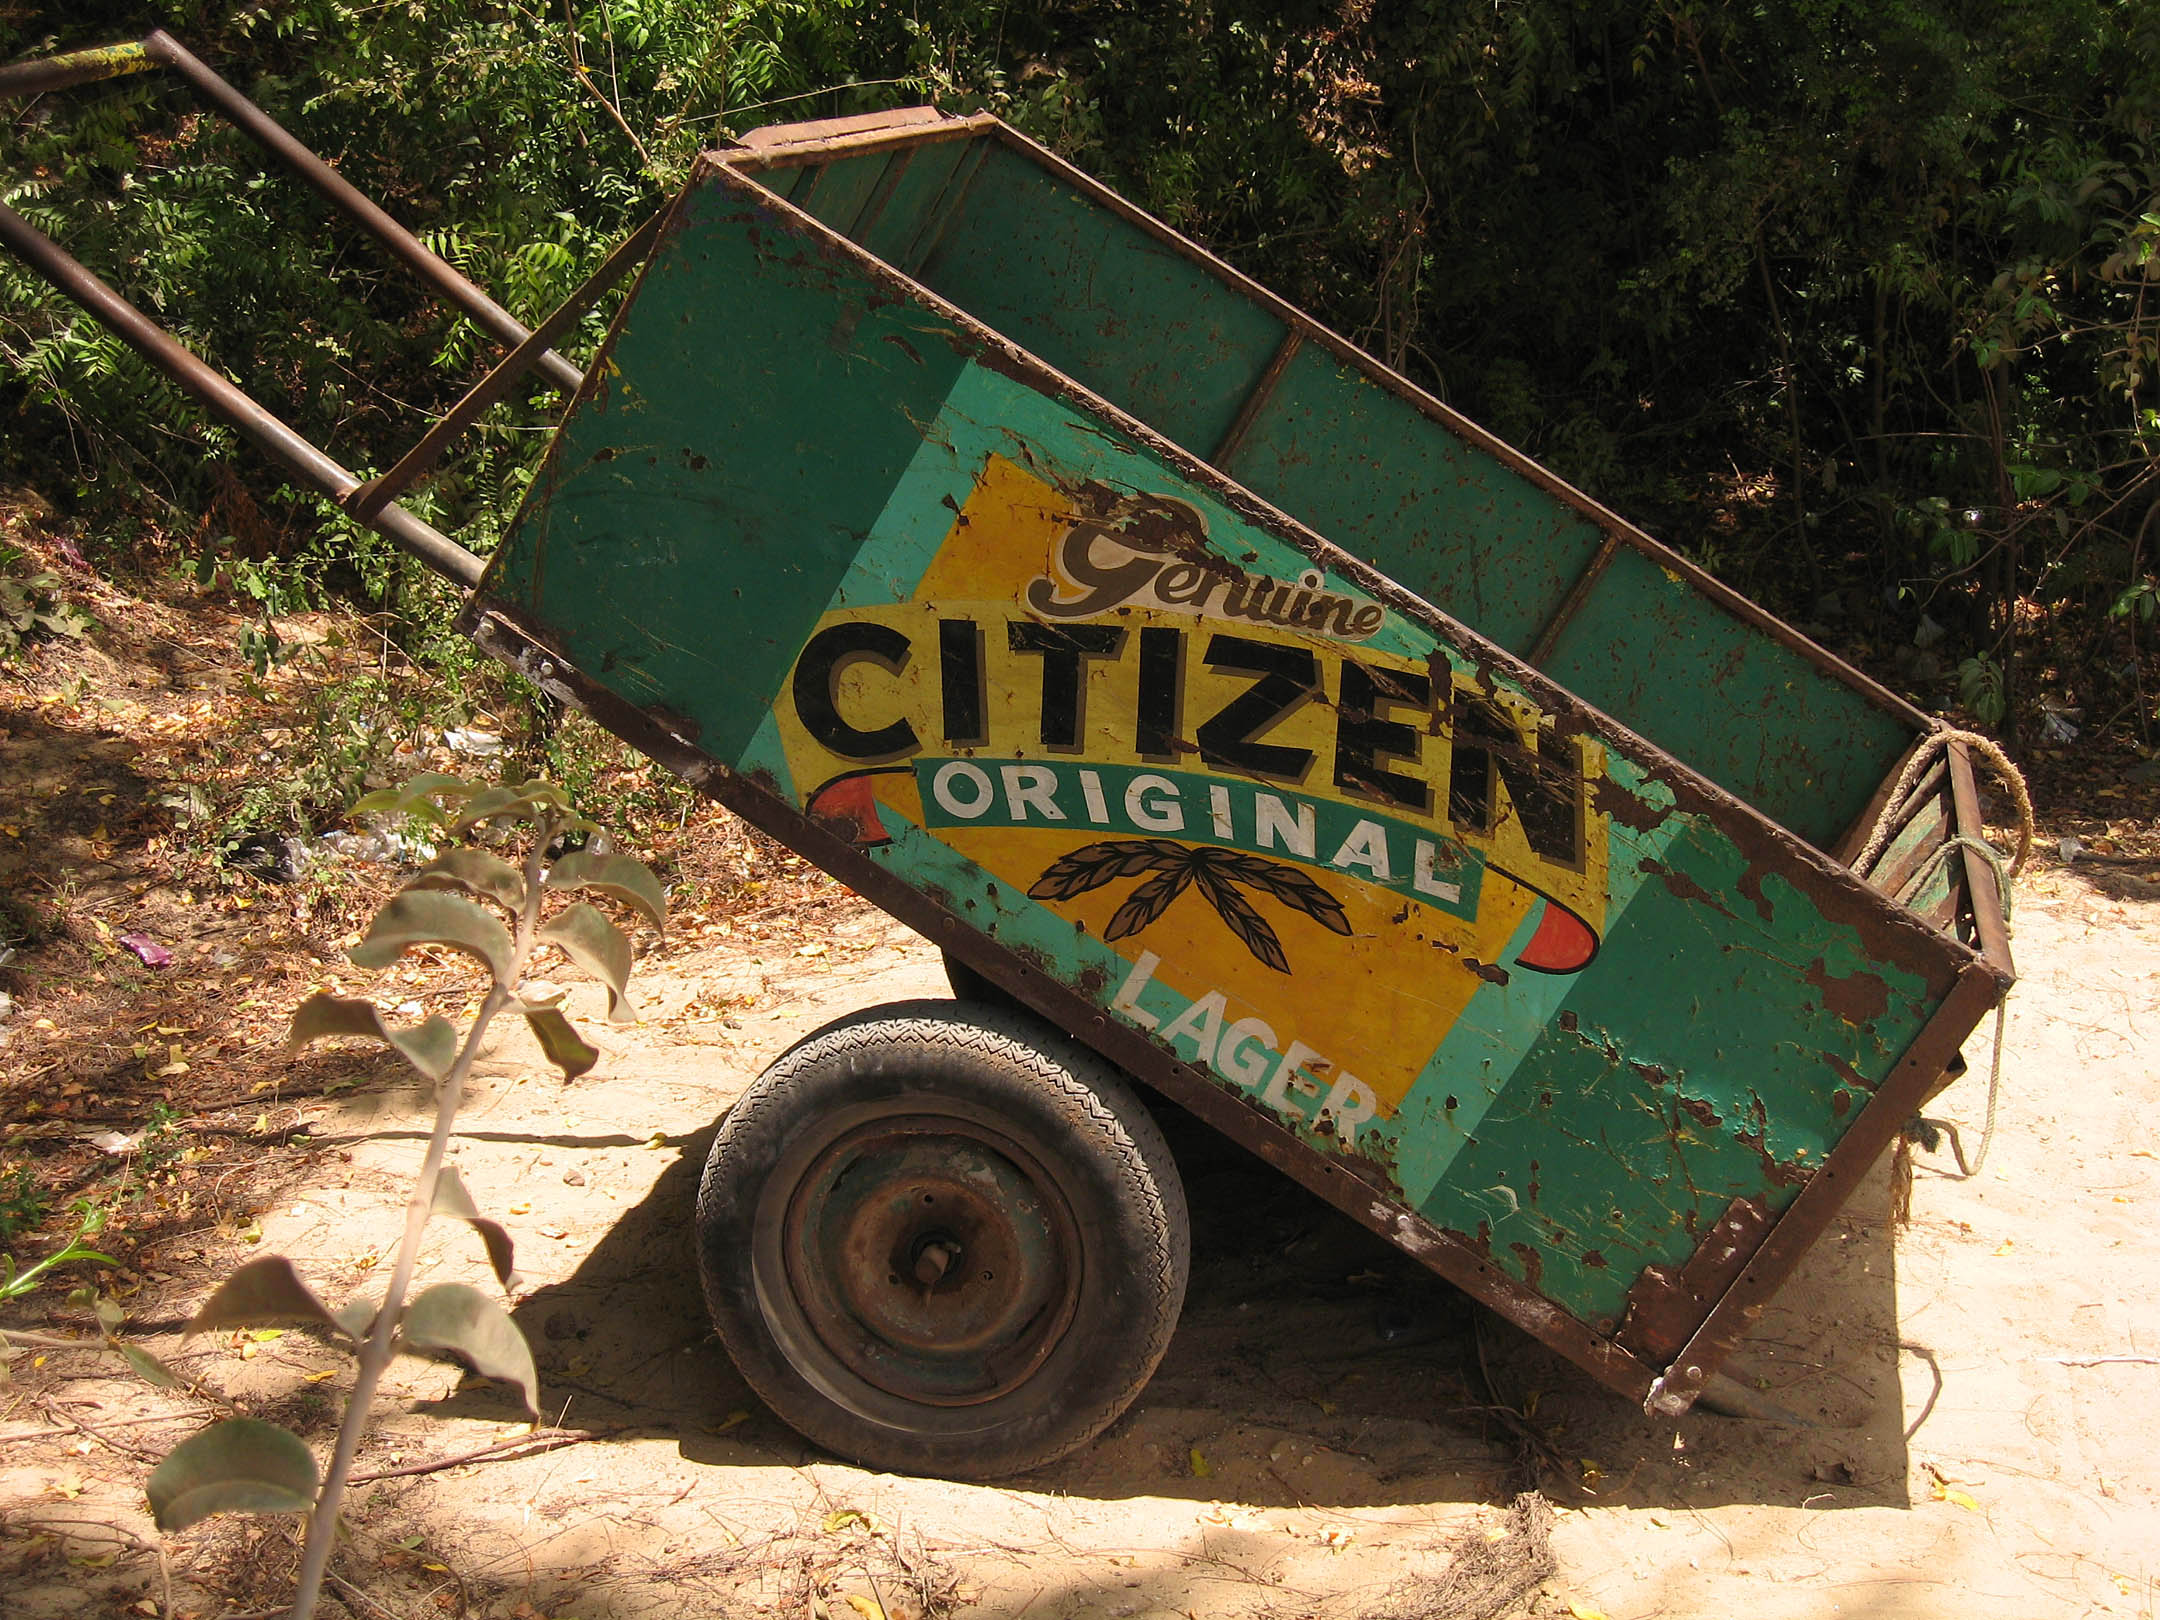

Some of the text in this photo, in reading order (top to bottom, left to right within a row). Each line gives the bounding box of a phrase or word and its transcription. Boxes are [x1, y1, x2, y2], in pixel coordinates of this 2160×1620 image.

[1028, 494, 1385, 642] Genuine
[793, 618, 1586, 874] CITIZEN
[932, 761, 1462, 904] ORIGINAL
[1111, 949, 1377, 1154] LAGER
